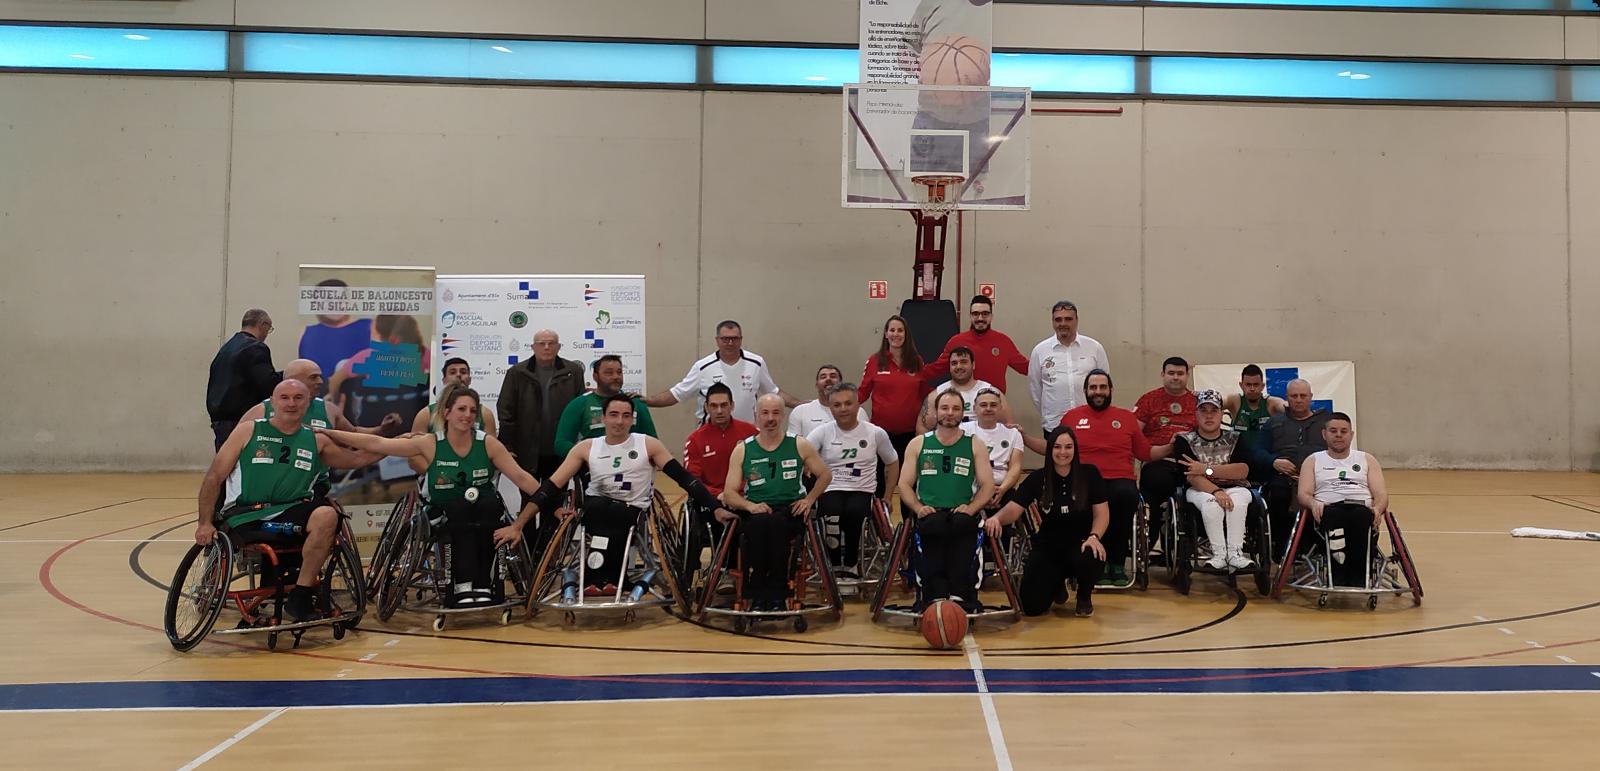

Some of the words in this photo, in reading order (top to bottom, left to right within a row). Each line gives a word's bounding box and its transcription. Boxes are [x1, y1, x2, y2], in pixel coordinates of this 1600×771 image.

[300, 289, 348, 300] ESCUELA
[351, 290, 365, 300] DE
[367, 290, 433, 301] BALONCESTO
[506, 292, 529, 301] Suma
[310, 301, 325, 311] EN
[328, 301, 360, 312] SILLA
[362, 302, 376, 312] DE
[379, 302, 420, 312] RUEDAS
[572, 341, 596, 349] Suma
[279, 445, 291, 465] 2
[841, 447, 858, 460] 73
[612, 456, 622, 469] 5
[942, 455, 952, 474] 5
[768, 461, 778, 480] 7
[457, 471, 467, 486] 3
